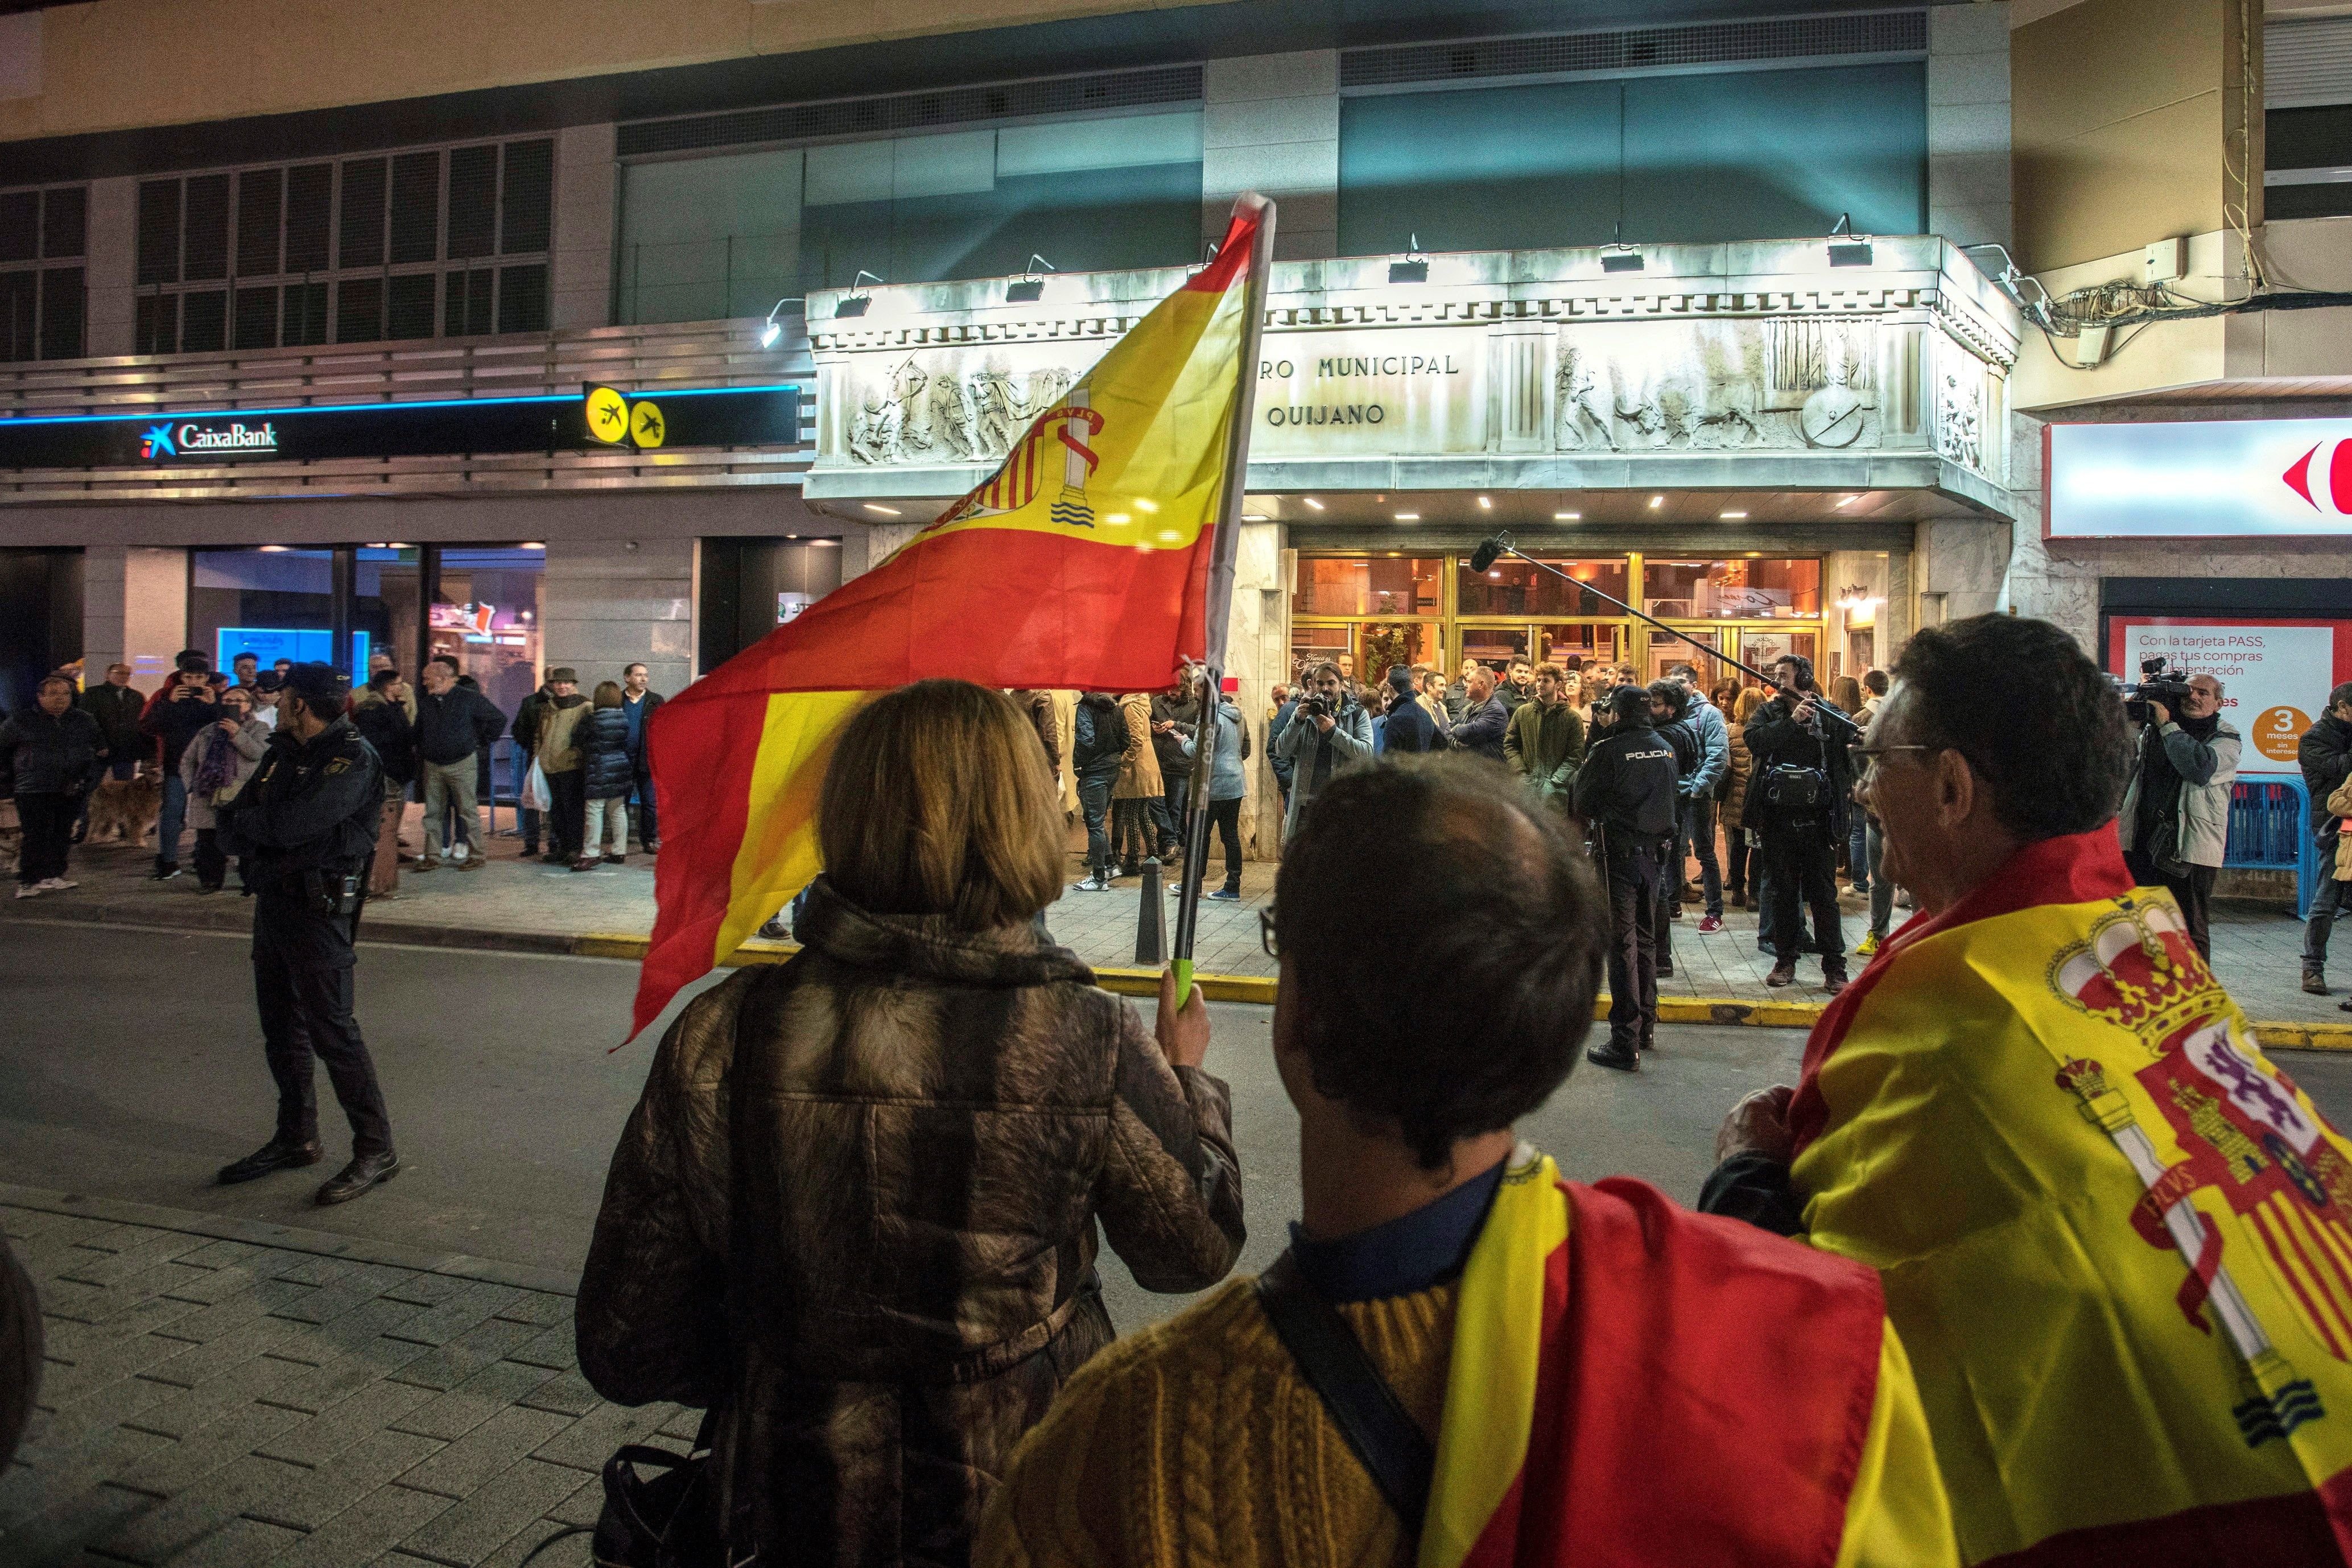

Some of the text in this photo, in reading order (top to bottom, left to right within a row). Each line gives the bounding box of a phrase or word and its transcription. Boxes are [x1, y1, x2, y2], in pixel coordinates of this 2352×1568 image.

[1260, 355, 1459, 379] RO MUNICIPAL
[1268, 404, 1384, 427] QUIJANO
[178, 422, 278, 448] CaixaBank
[2139, 636, 2266, 648] Con la tarjeta PASS,
[2180, 651, 2201, 660] tus
[2204, 653, 2263, 663] compras
[2167, 665, 2243, 675] limentación
[2222, 698, 2238, 707] es
[2273, 709, 2293, 732] 3
[1625, 749, 1669, 761] POLICIA
